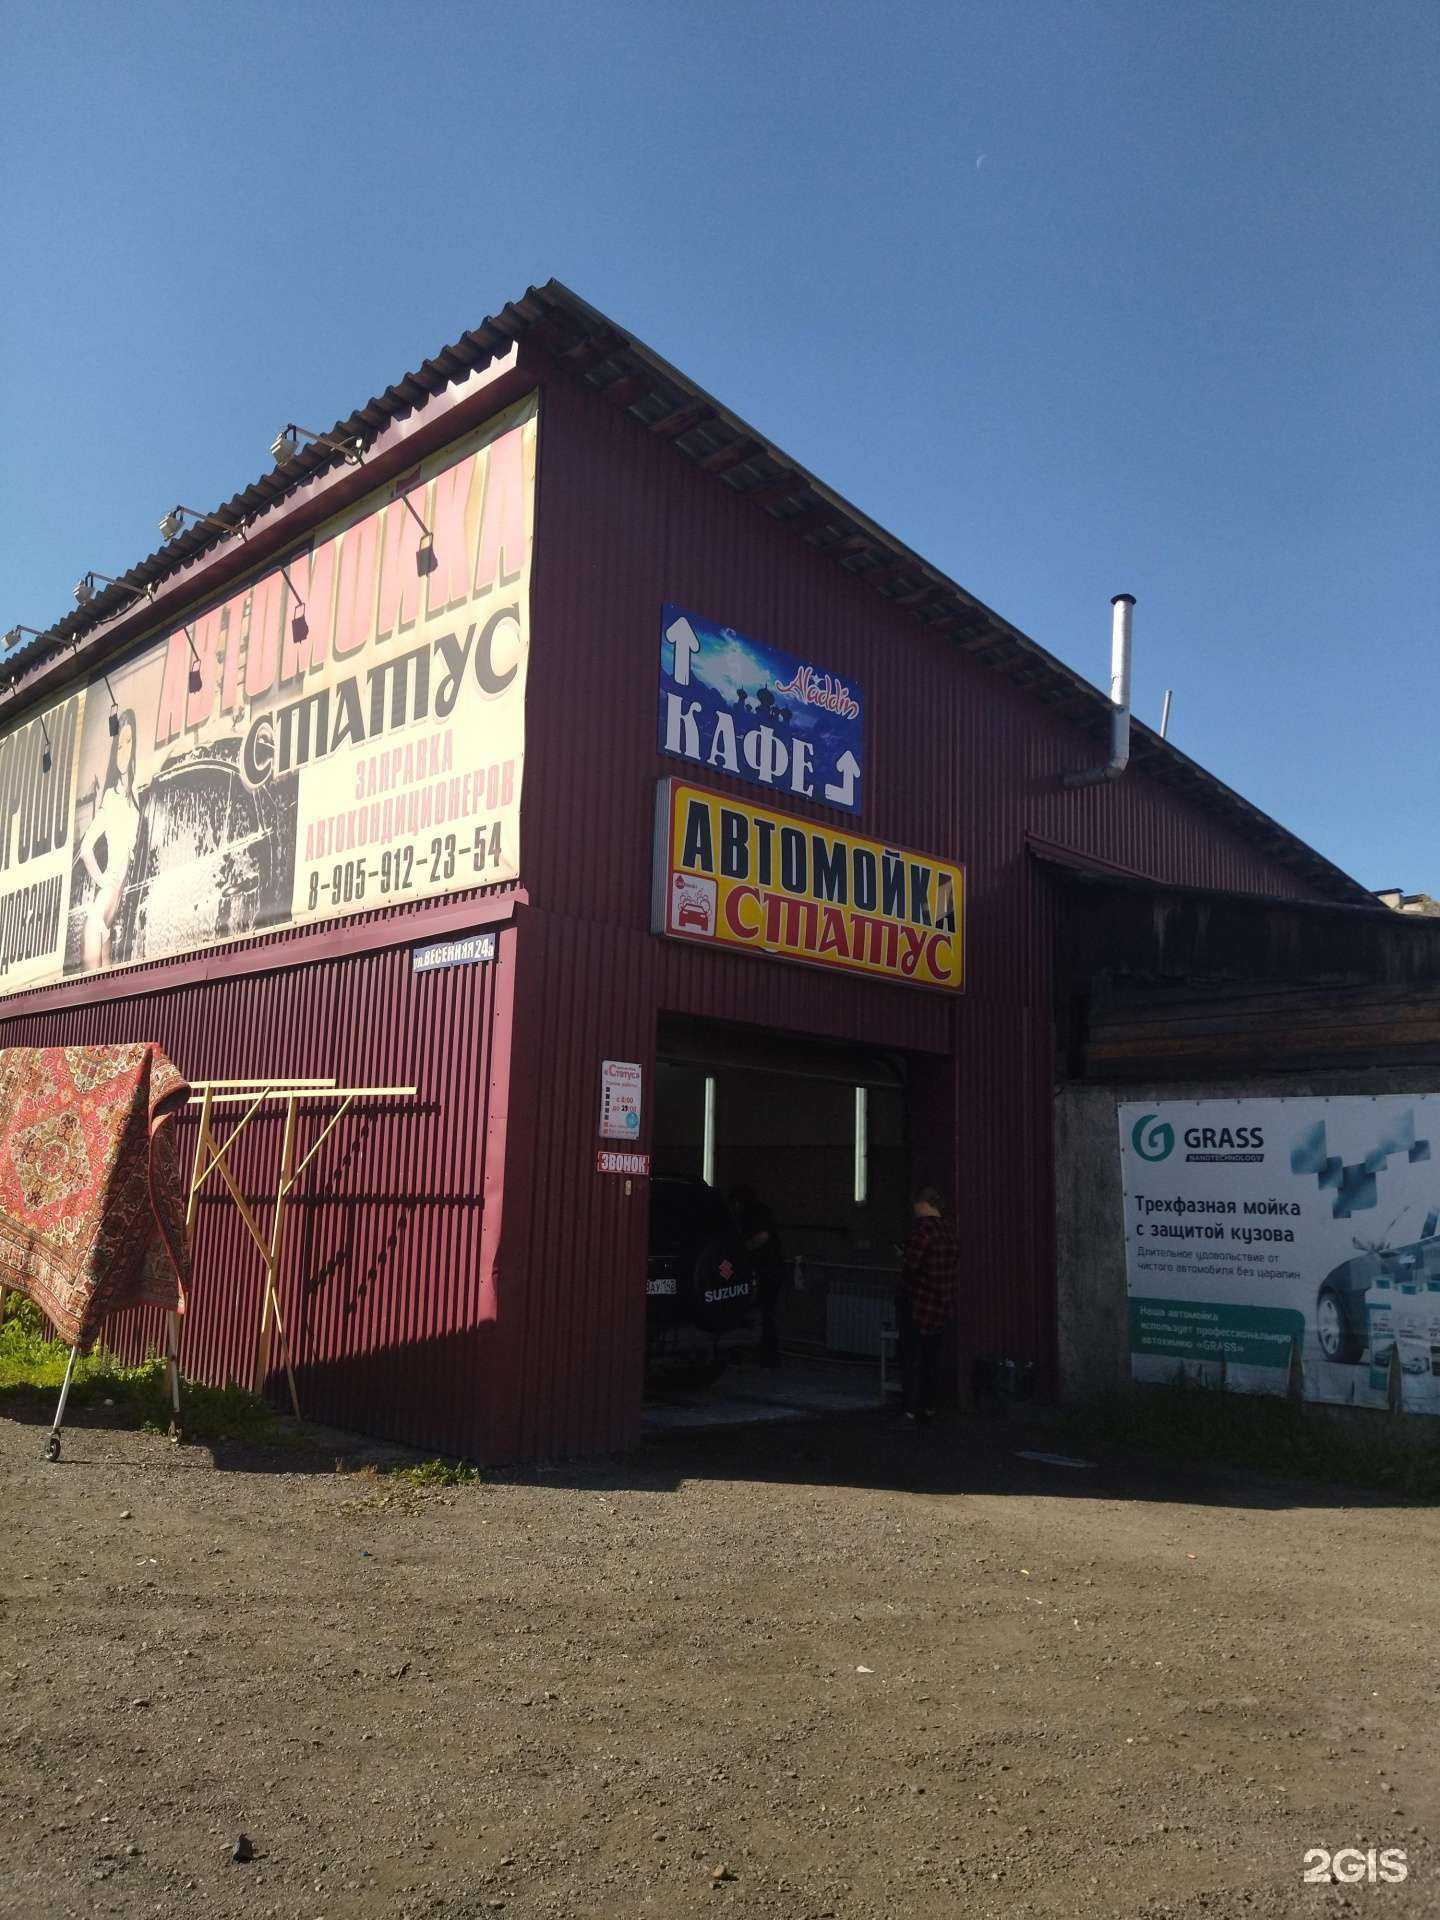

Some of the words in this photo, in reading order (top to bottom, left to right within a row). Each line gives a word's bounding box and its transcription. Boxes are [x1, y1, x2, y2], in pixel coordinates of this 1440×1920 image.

[242, 602, 521, 785] СТАТУС
[774, 665, 860, 720] Aladdin
[355, 729, 453, 800] ЗАПРАВКА
[665, 692, 814, 798] КАФЕ
[305, 760, 514, 862] АВТОКОНДИЦИОНЕРОВ
[308, 821, 501, 911] 8-905-912-23-54
[682, 800, 956, 934] АВТОМОЙКА
[725, 885, 952, 980] СТАТУС
[601, 1154, 646, 1173] ЗВОНОК
[1184, 1128, 1264, 1149] GRASS
[1135, 1195, 1236, 1216] Трехфазная
[1243, 1198, 1301, 1216] мойка
[1136, 1224, 1144, 1236] с
[1151, 1223, 1224, 1239] защитой
[1231, 1227, 1295, 1244] кузова
[1137, 1246, 1192, 1258] Длительное
[1196, 1251, 1265, 1263] удовольствие
[704, 1283, 749, 1303] SUZUKI
[1176, 1264, 1233, 1276] автомобиля
